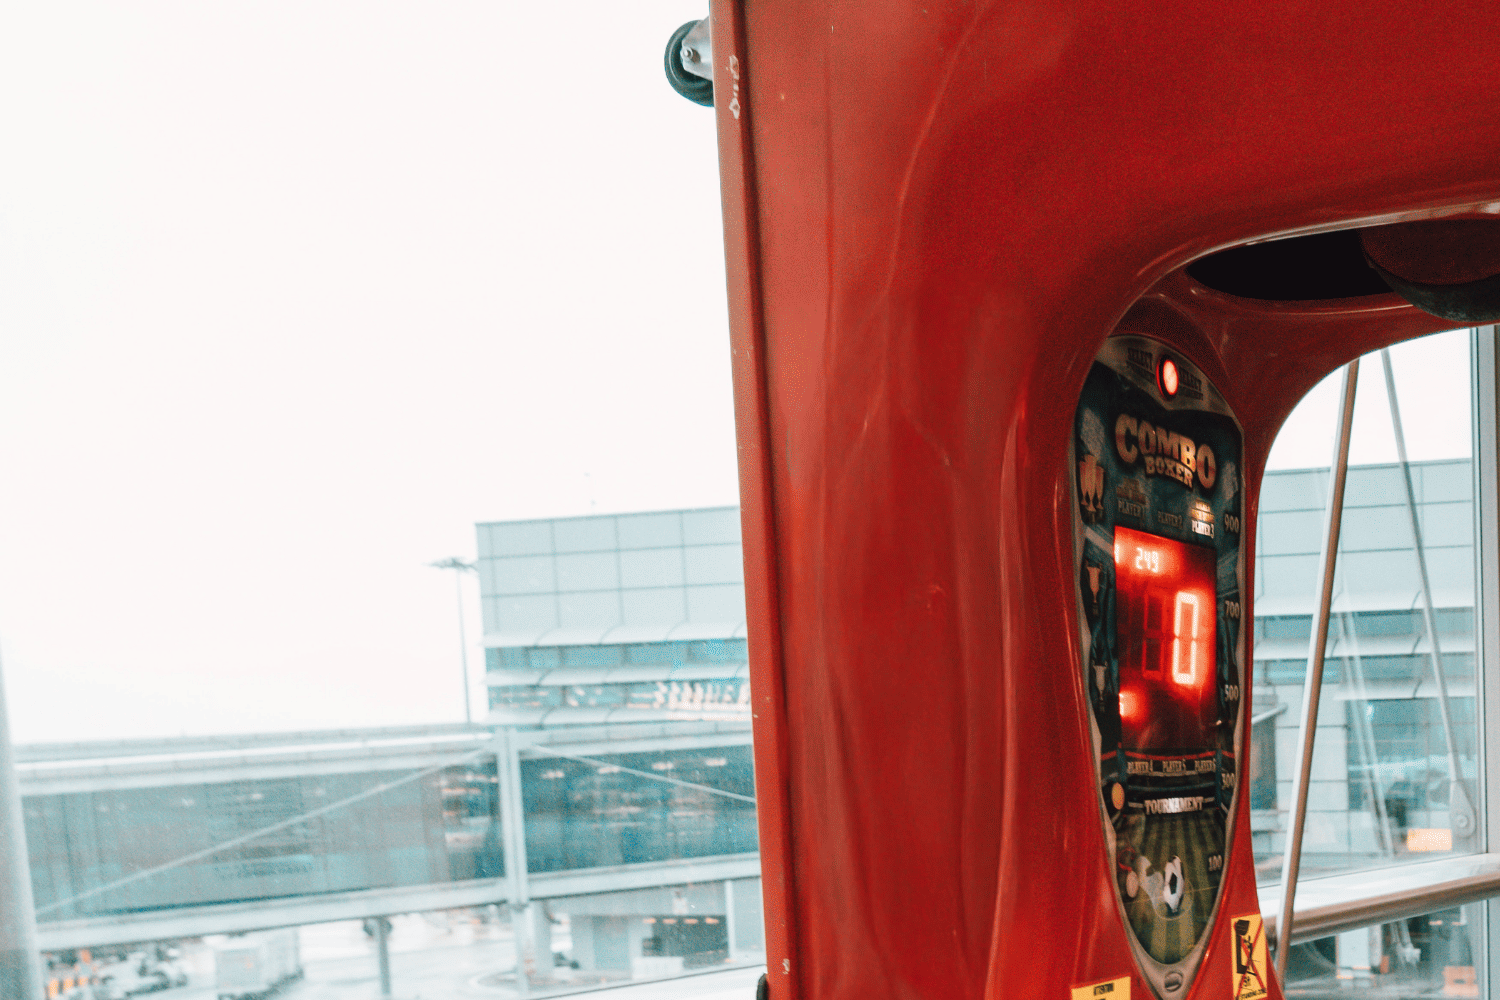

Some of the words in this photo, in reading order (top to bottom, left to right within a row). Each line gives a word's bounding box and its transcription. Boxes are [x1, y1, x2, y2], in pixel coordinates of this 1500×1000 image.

[1115, 413, 1217, 490] COMBO
[1144, 455, 1193, 488] BOXER
[1118, 498, 1142, 518] PLAYER
[1158, 511, 1178, 528] PLAYER
[1192, 520, 1210, 536] PLAYER
[1224, 514, 1240, 534] 900
[1224, 598, 1240, 620] 700
[1224, 682, 1240, 702] 500
[1127, 761, 1149, 774] PLAYER
[1162, 760, 1182, 773] PLAYER
[1194, 760, 1212, 772] PLAYER
[1222, 773, 1235, 790] 300
[1144, 796, 1204, 816] TOURNAMENT
[1208, 854, 1222, 872] 100
